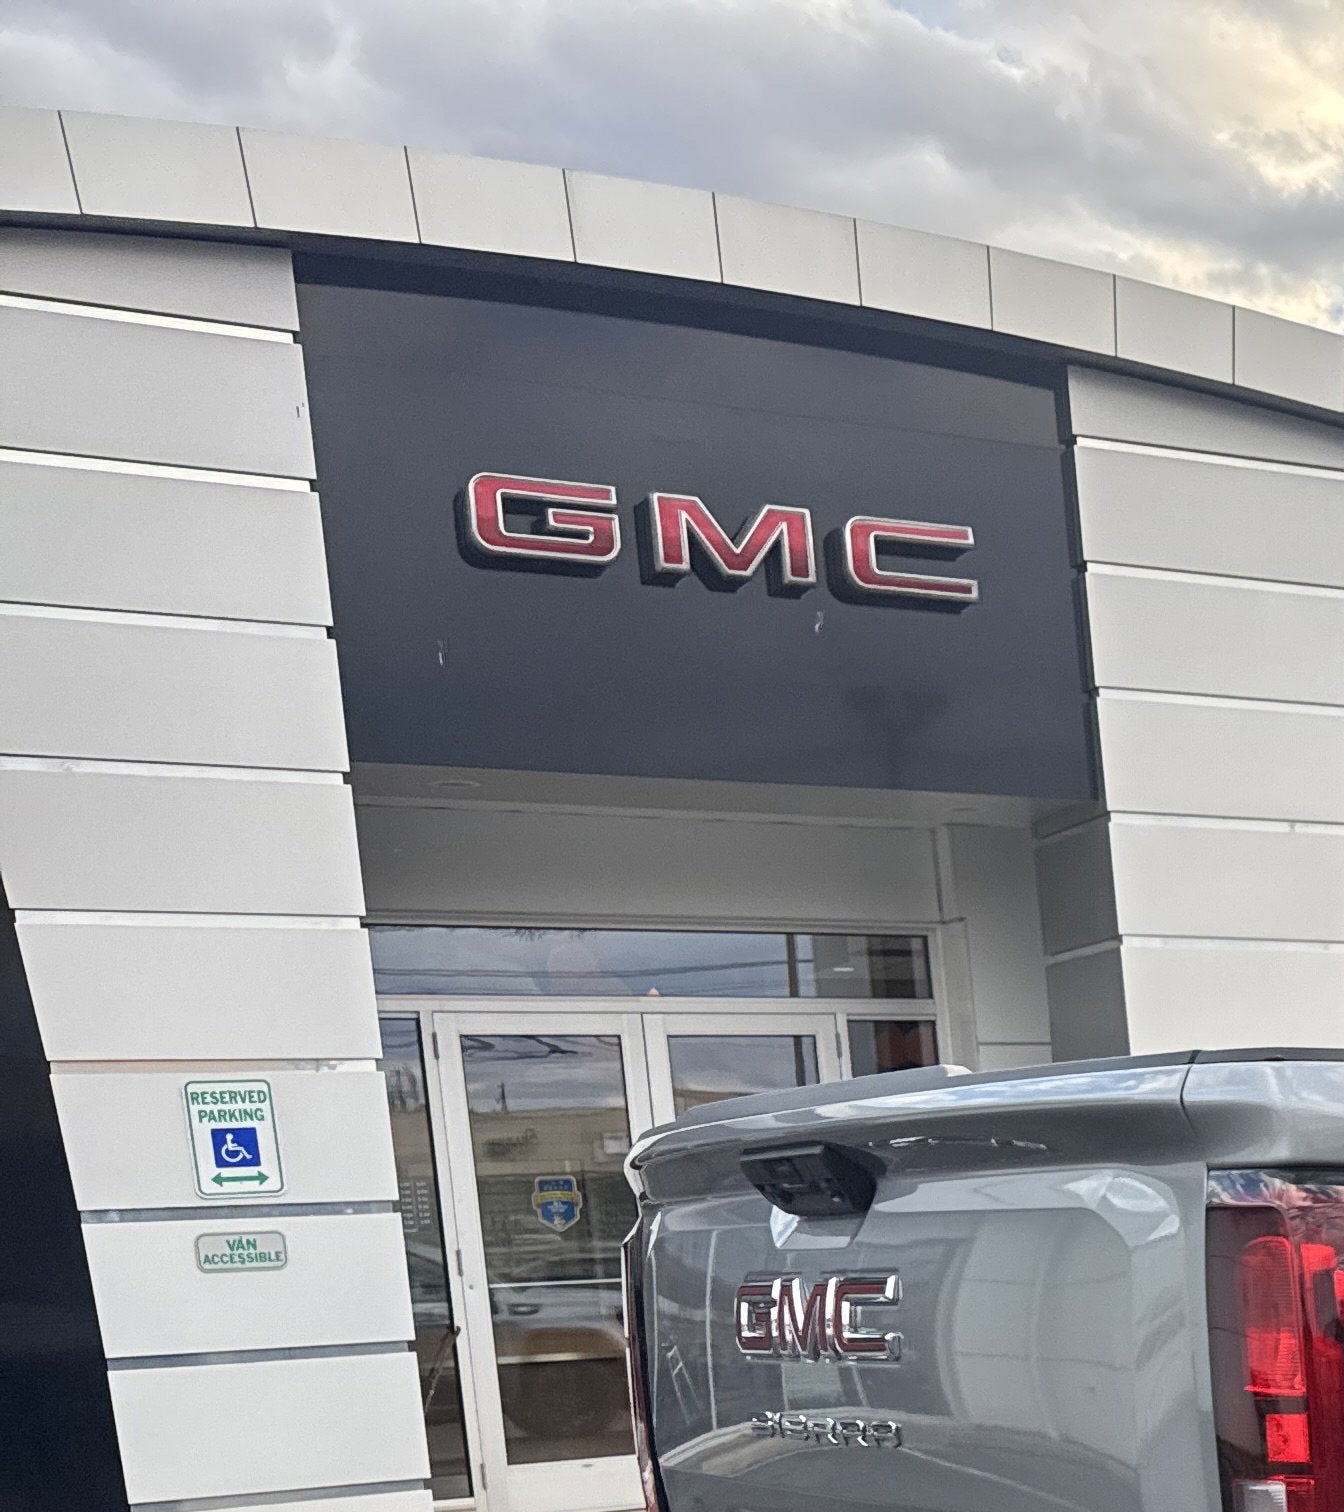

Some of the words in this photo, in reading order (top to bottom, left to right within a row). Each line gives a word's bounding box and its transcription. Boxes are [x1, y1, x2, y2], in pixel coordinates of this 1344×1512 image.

[467, 471, 979, 600] GMC
[189, 1089, 267, 1106] RESERVED
[198, 1107, 265, 1123] PARKING
[225, 1237, 258, 1252] VAN
[203, 1250, 284, 1266] ACCESSIBLE
[735, 1271, 904, 1361] GMC
